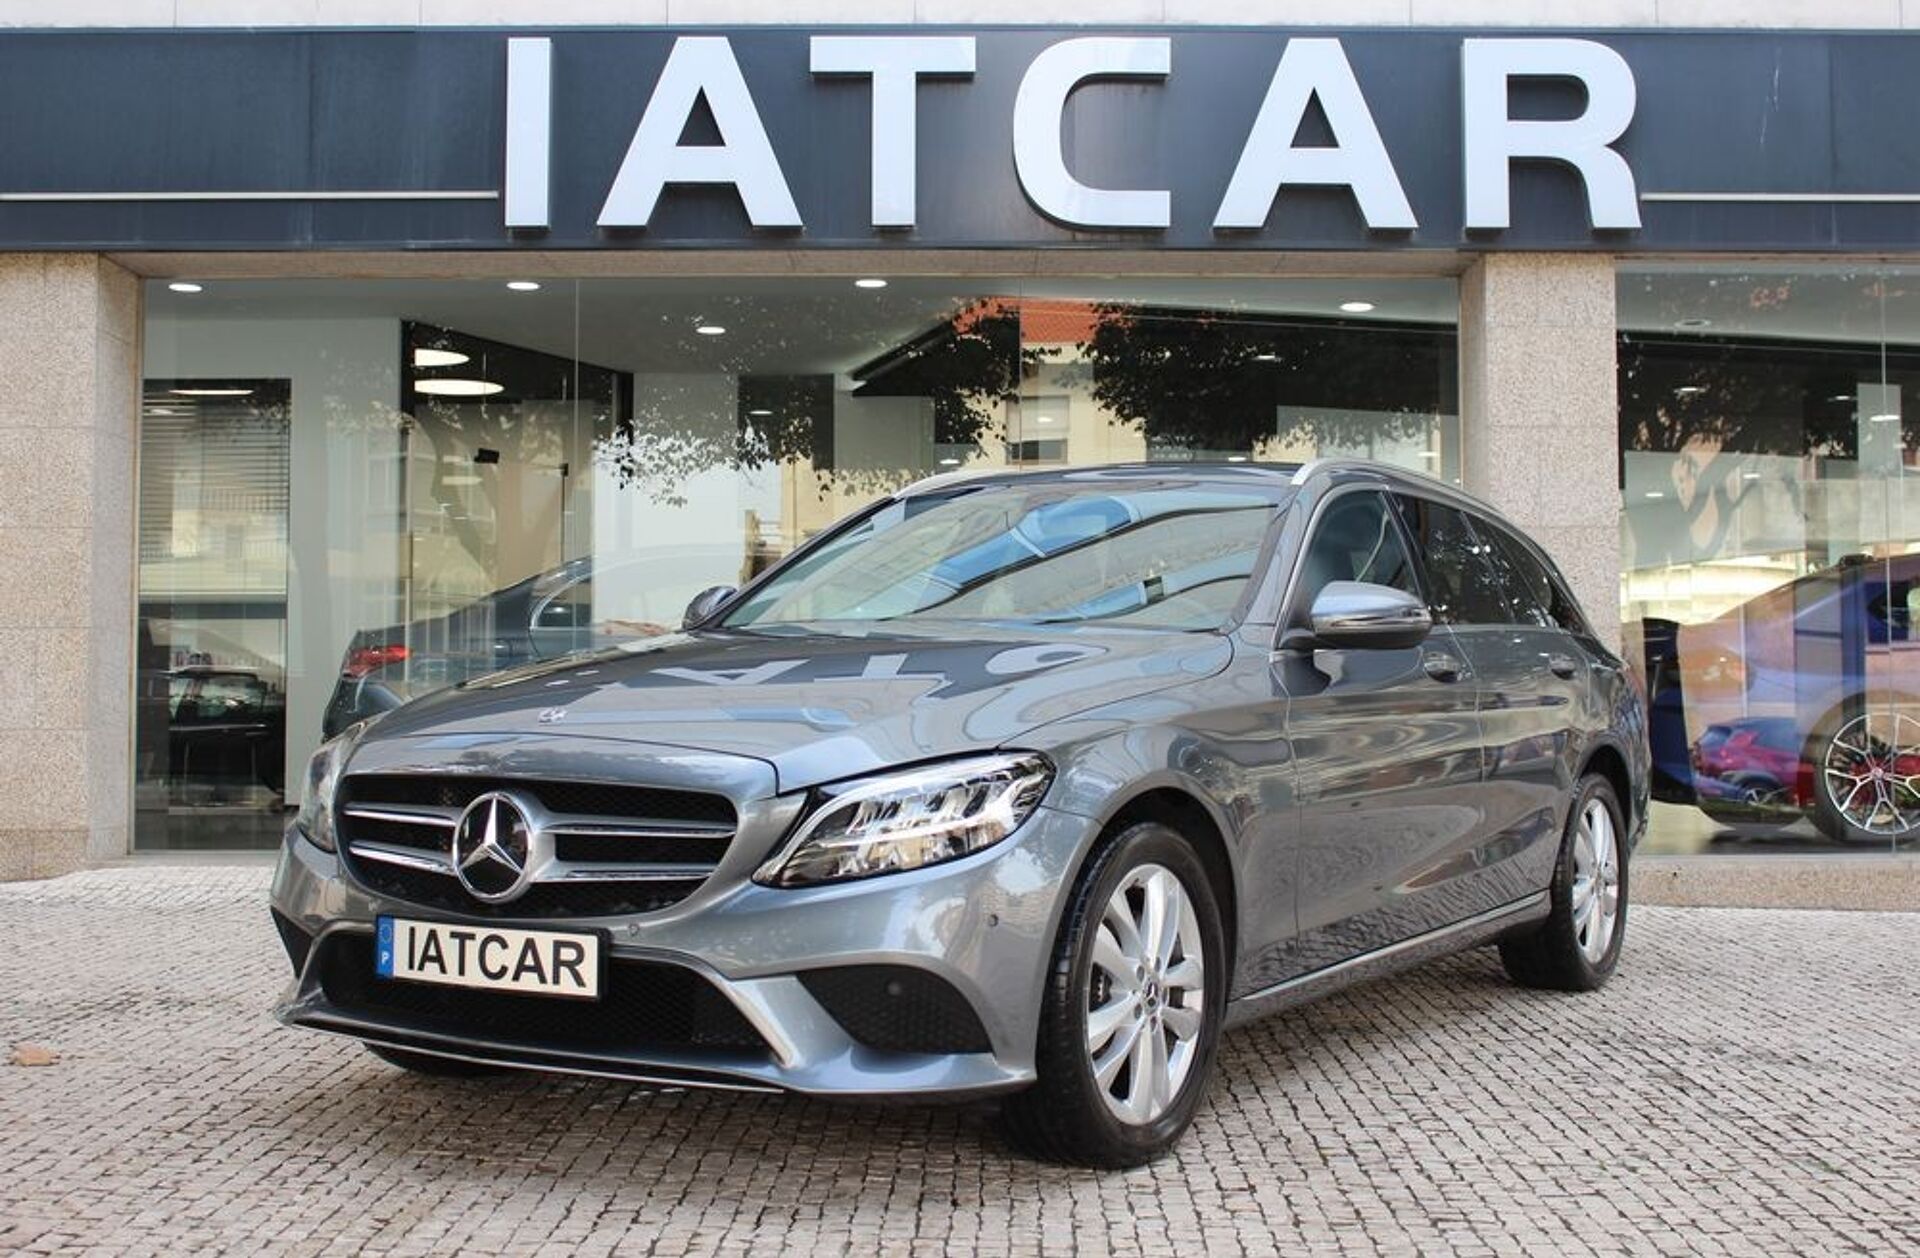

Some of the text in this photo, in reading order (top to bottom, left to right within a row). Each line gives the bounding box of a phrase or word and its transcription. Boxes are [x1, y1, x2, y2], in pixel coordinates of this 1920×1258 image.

[505, 36, 1640, 229] IATCAR
[381, 951, 390, 965] P
[408, 926, 586, 987] IATCAR
